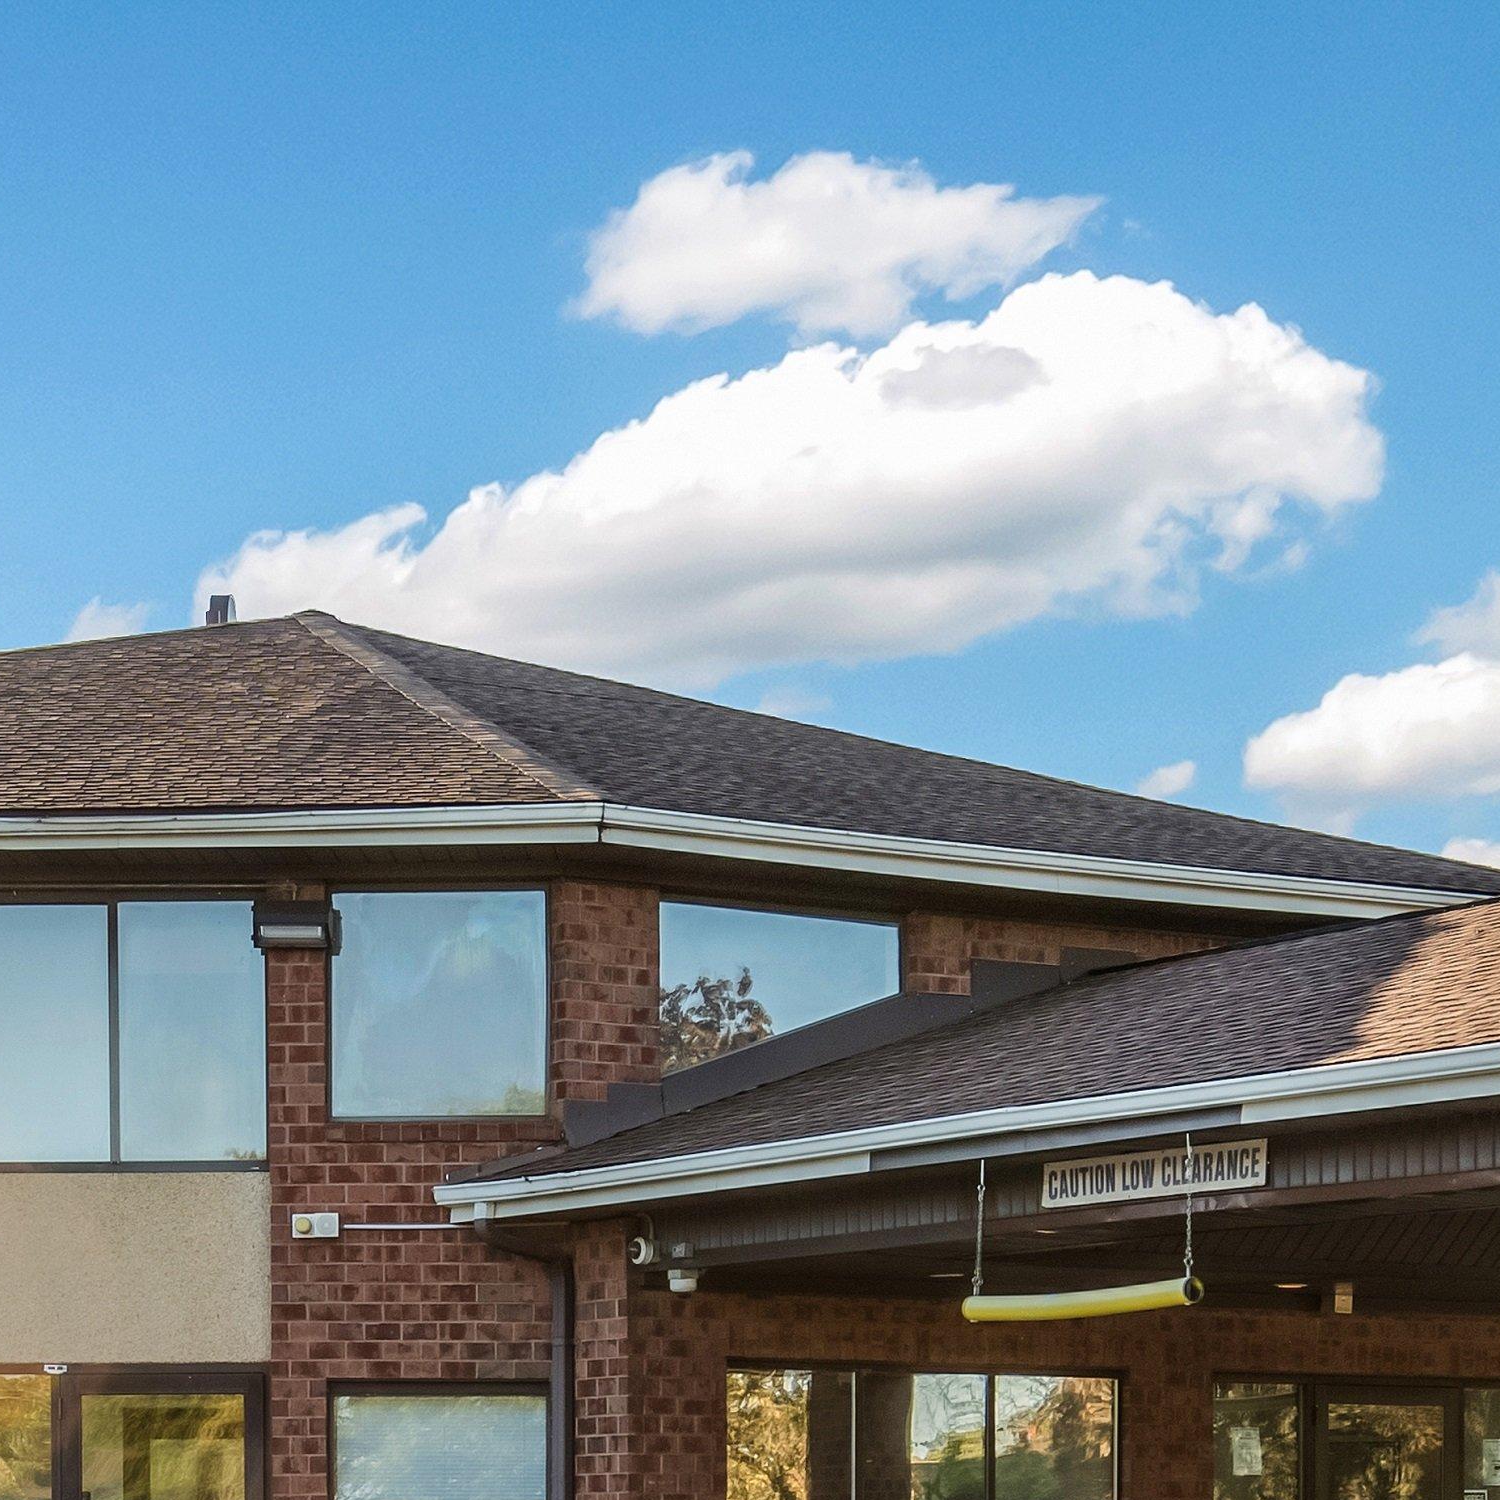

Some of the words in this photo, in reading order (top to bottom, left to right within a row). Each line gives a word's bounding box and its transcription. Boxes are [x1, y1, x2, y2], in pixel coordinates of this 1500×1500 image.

[1048, 1162, 1116, 1201] CAUTION
[1121, 1158, 1156, 1192] LOW
[1161, 1147, 1261, 1188] CLEARANCE
